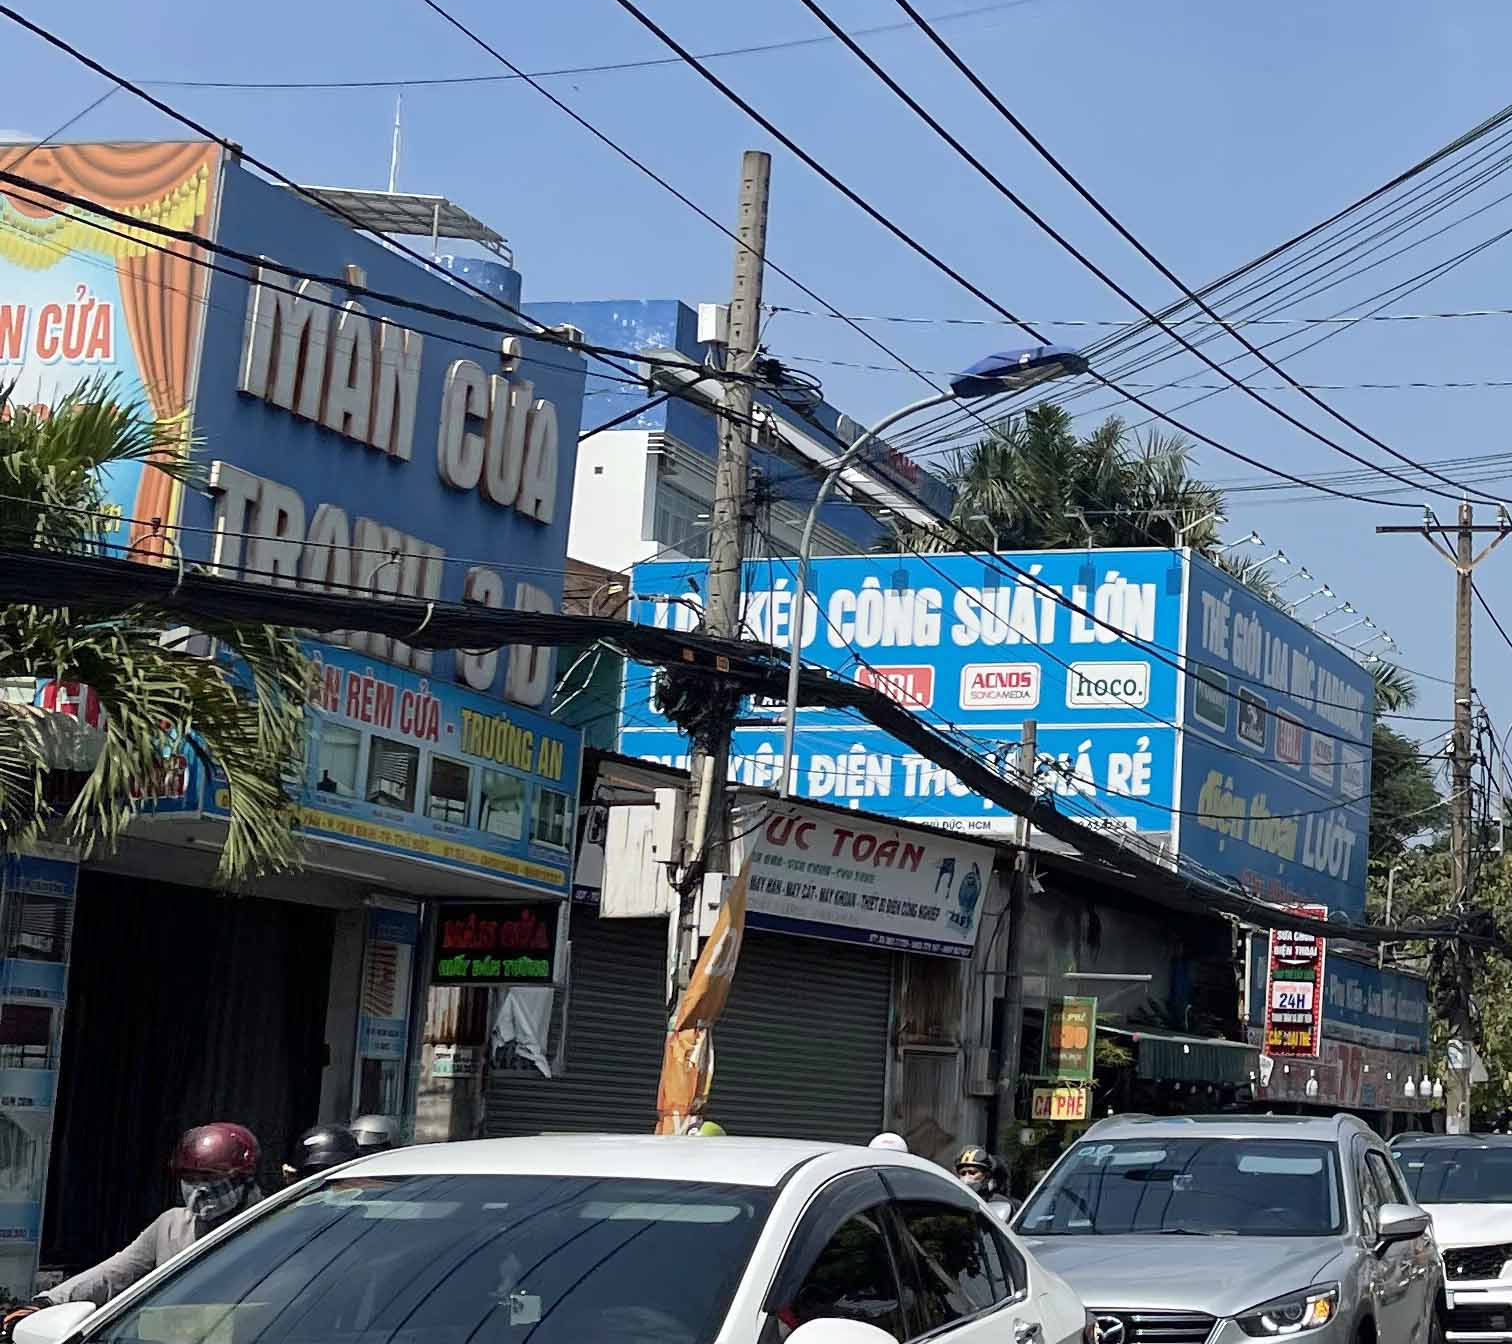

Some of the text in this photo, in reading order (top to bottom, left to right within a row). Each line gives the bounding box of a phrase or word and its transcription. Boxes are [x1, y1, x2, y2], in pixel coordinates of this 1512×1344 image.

[35, 283, 113, 360] CỬA
[237, 255, 559, 525] MÀN CỬA
[738, 578, 819, 649] KÉO
[828, 576, 943, 647] CÔNG
[953, 564, 1061, 647] SUẤT
[1069, 570, 1156, 643] LỚN
[1202, 587, 1232, 661] THẾ
[1263, 630, 1289, 694] LOA
[971, 672, 1032, 689] ACNOS
[1075, 670, 1143, 697] hoco.
[400, 678, 441, 743] CỬA
[537, 736, 564, 781] AN
[808, 742, 893, 809] ĐIỆN
[1107, 736, 1152, 797] RẺ
[830, 828, 926, 873] TOÀN
[968, 821, 992, 830] HCM
[1279, 993, 1306, 1009] 24H
